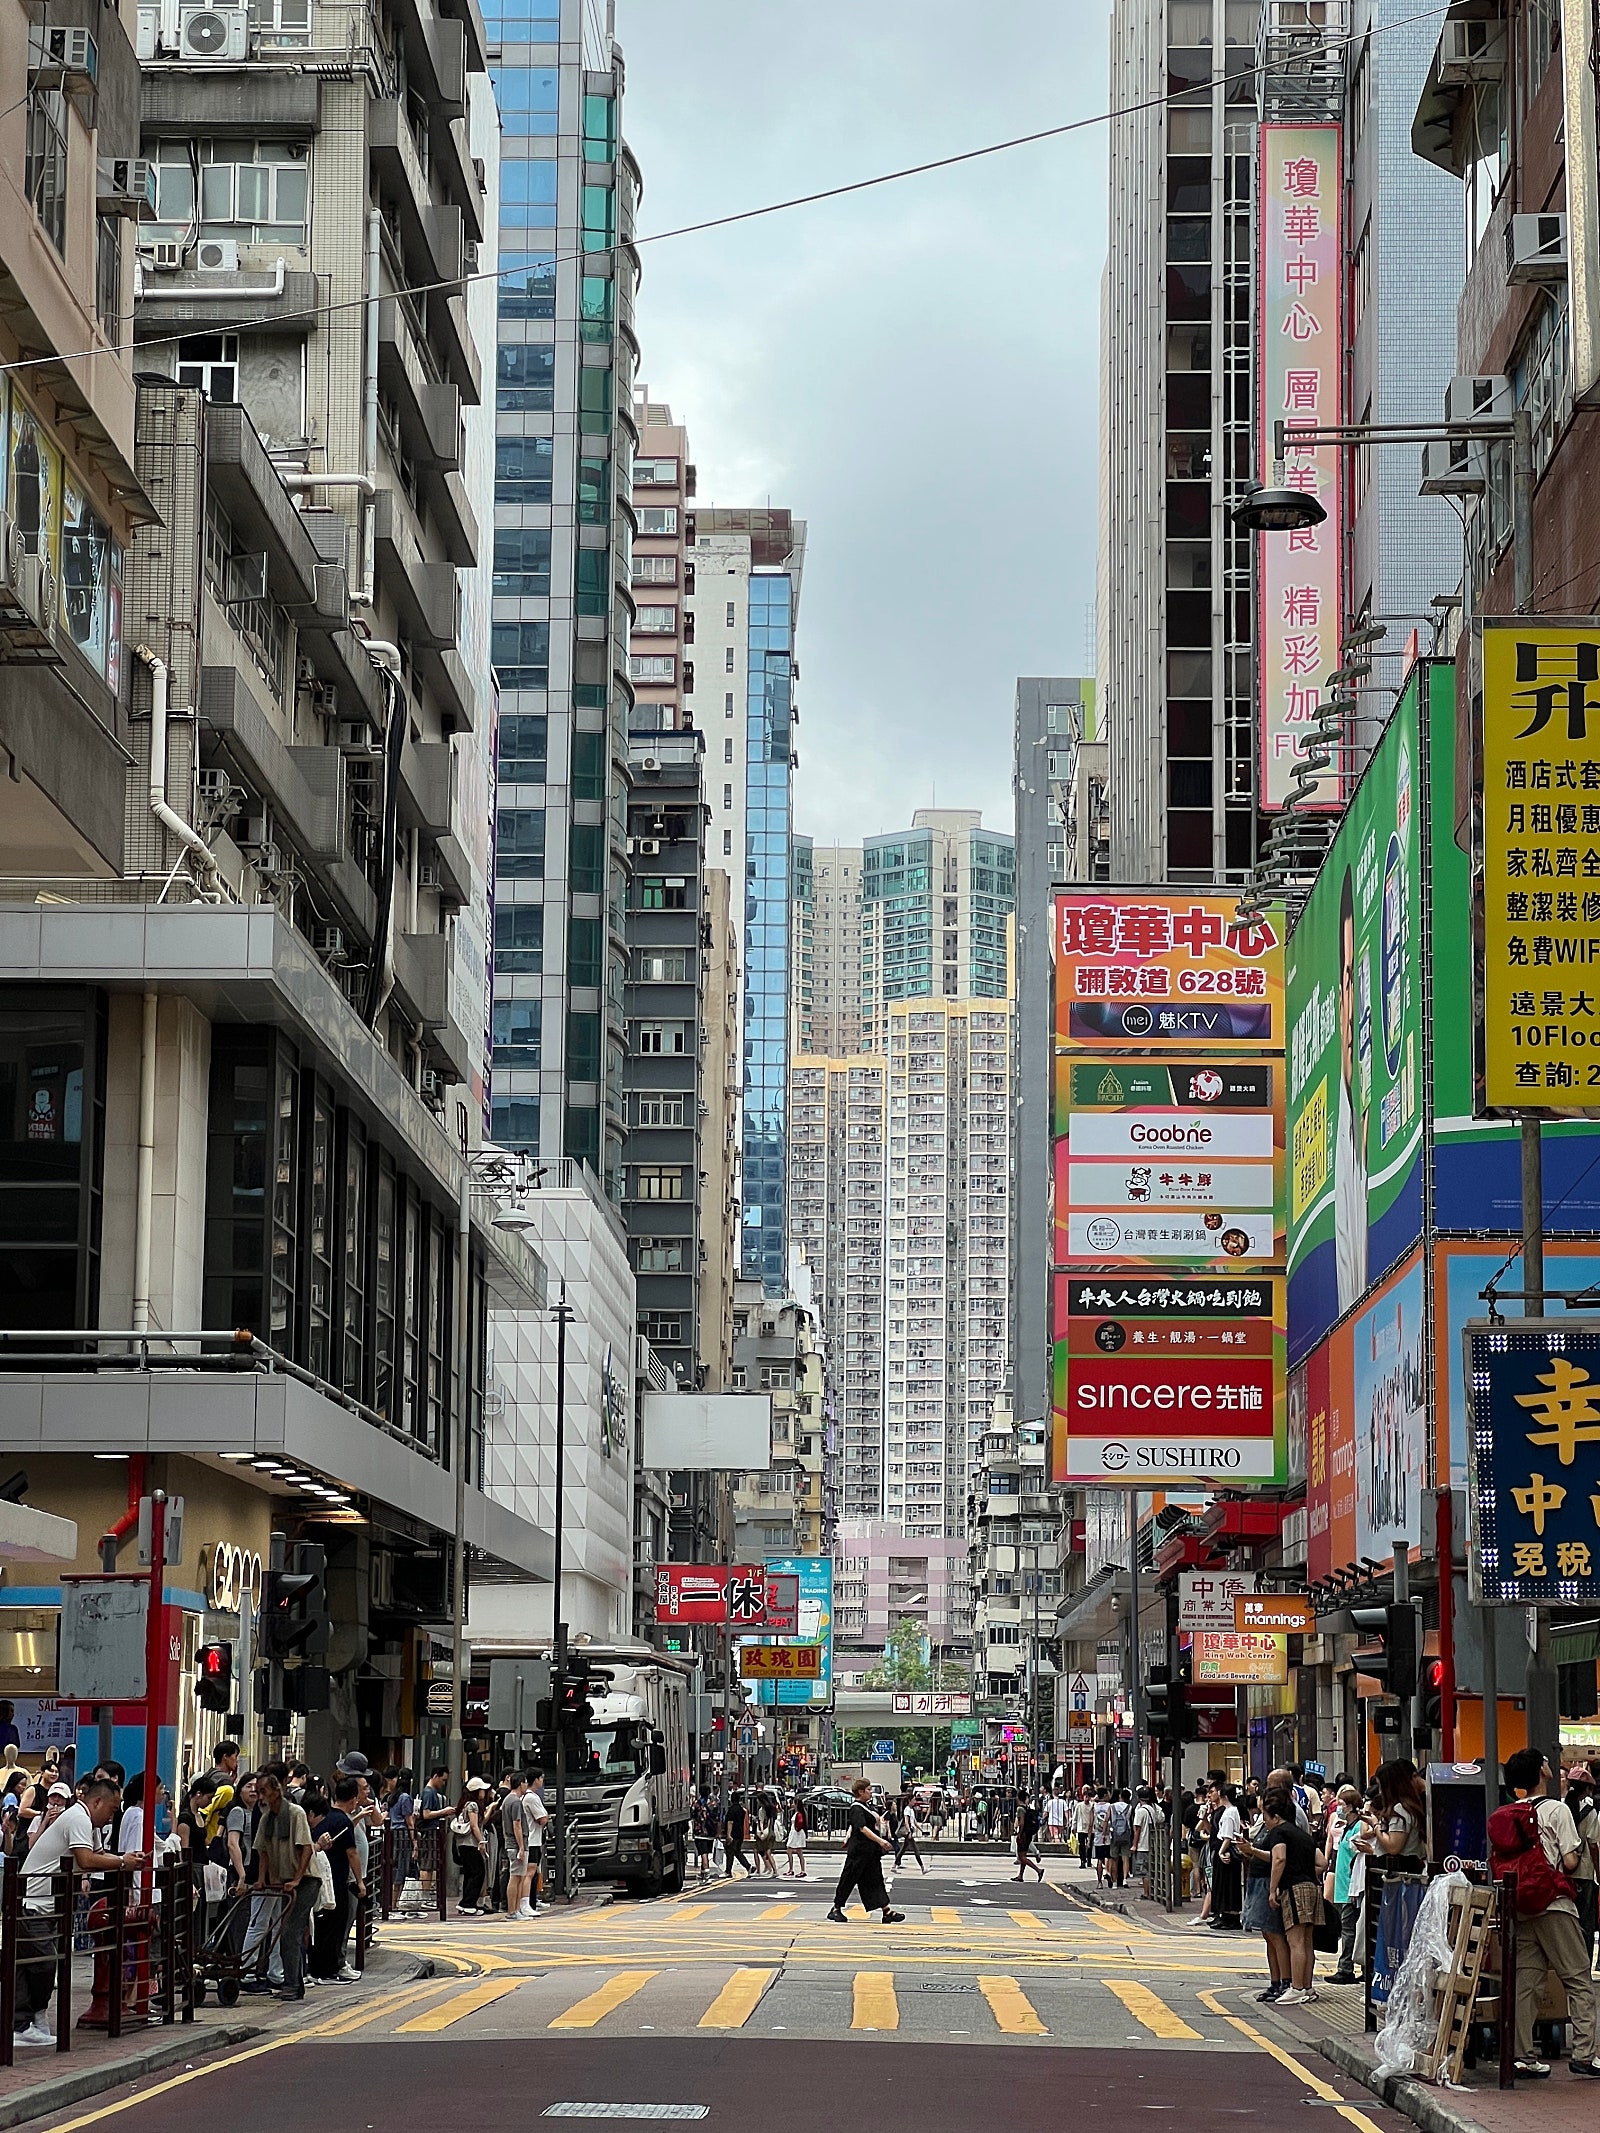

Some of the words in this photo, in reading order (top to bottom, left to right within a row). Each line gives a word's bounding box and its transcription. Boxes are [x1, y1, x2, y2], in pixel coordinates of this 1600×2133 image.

[1283, 158, 1320, 341] 瓊華中心
[1283, 585, 1320, 724] 精彩加
[1505, 759, 1600, 790] 酒店式套
[1506, 803, 1600, 834] 月租優惠
[1507, 847, 1600, 878] 家私齊全
[1506, 891, 1600, 923] 整潔裝修
[1065, 905, 1278, 958] 瓊華中心
[1076, 966, 1169, 996] 彌敦道
[1179, 968, 1267, 997] 628號
[1509, 990, 1600, 1017] 遠景大
[1158, 1012, 1219, 1031] 魅KTV
[1130, 1122, 1213, 1143] Goobne
[1158, 1172, 1213, 1187] 牛牛鮮
[1123, 1229, 1207, 1242] 台灣養生涮涮鍋
[1078, 1286, 1263, 1310] 牛大人台灣火鍋吃到飽
[1077, 1384, 1212, 1409] sincere
[1215, 1384, 1263, 1410] 先施
[1100, 1452, 1131, 1461] スシロー
[1136, 1447, 1241, 1468] SUSHIRO
[748, 1568, 763, 1578] 1/F
[1244, 1613, 1306, 1627] mannings
[1204, 1632, 1277, 1651] 瓊華中心
[1205, 1652, 1224, 1660] King
[1230, 1672, 1260, 1680] Beverage
[543, 1789, 590, 1800] SCNIA
